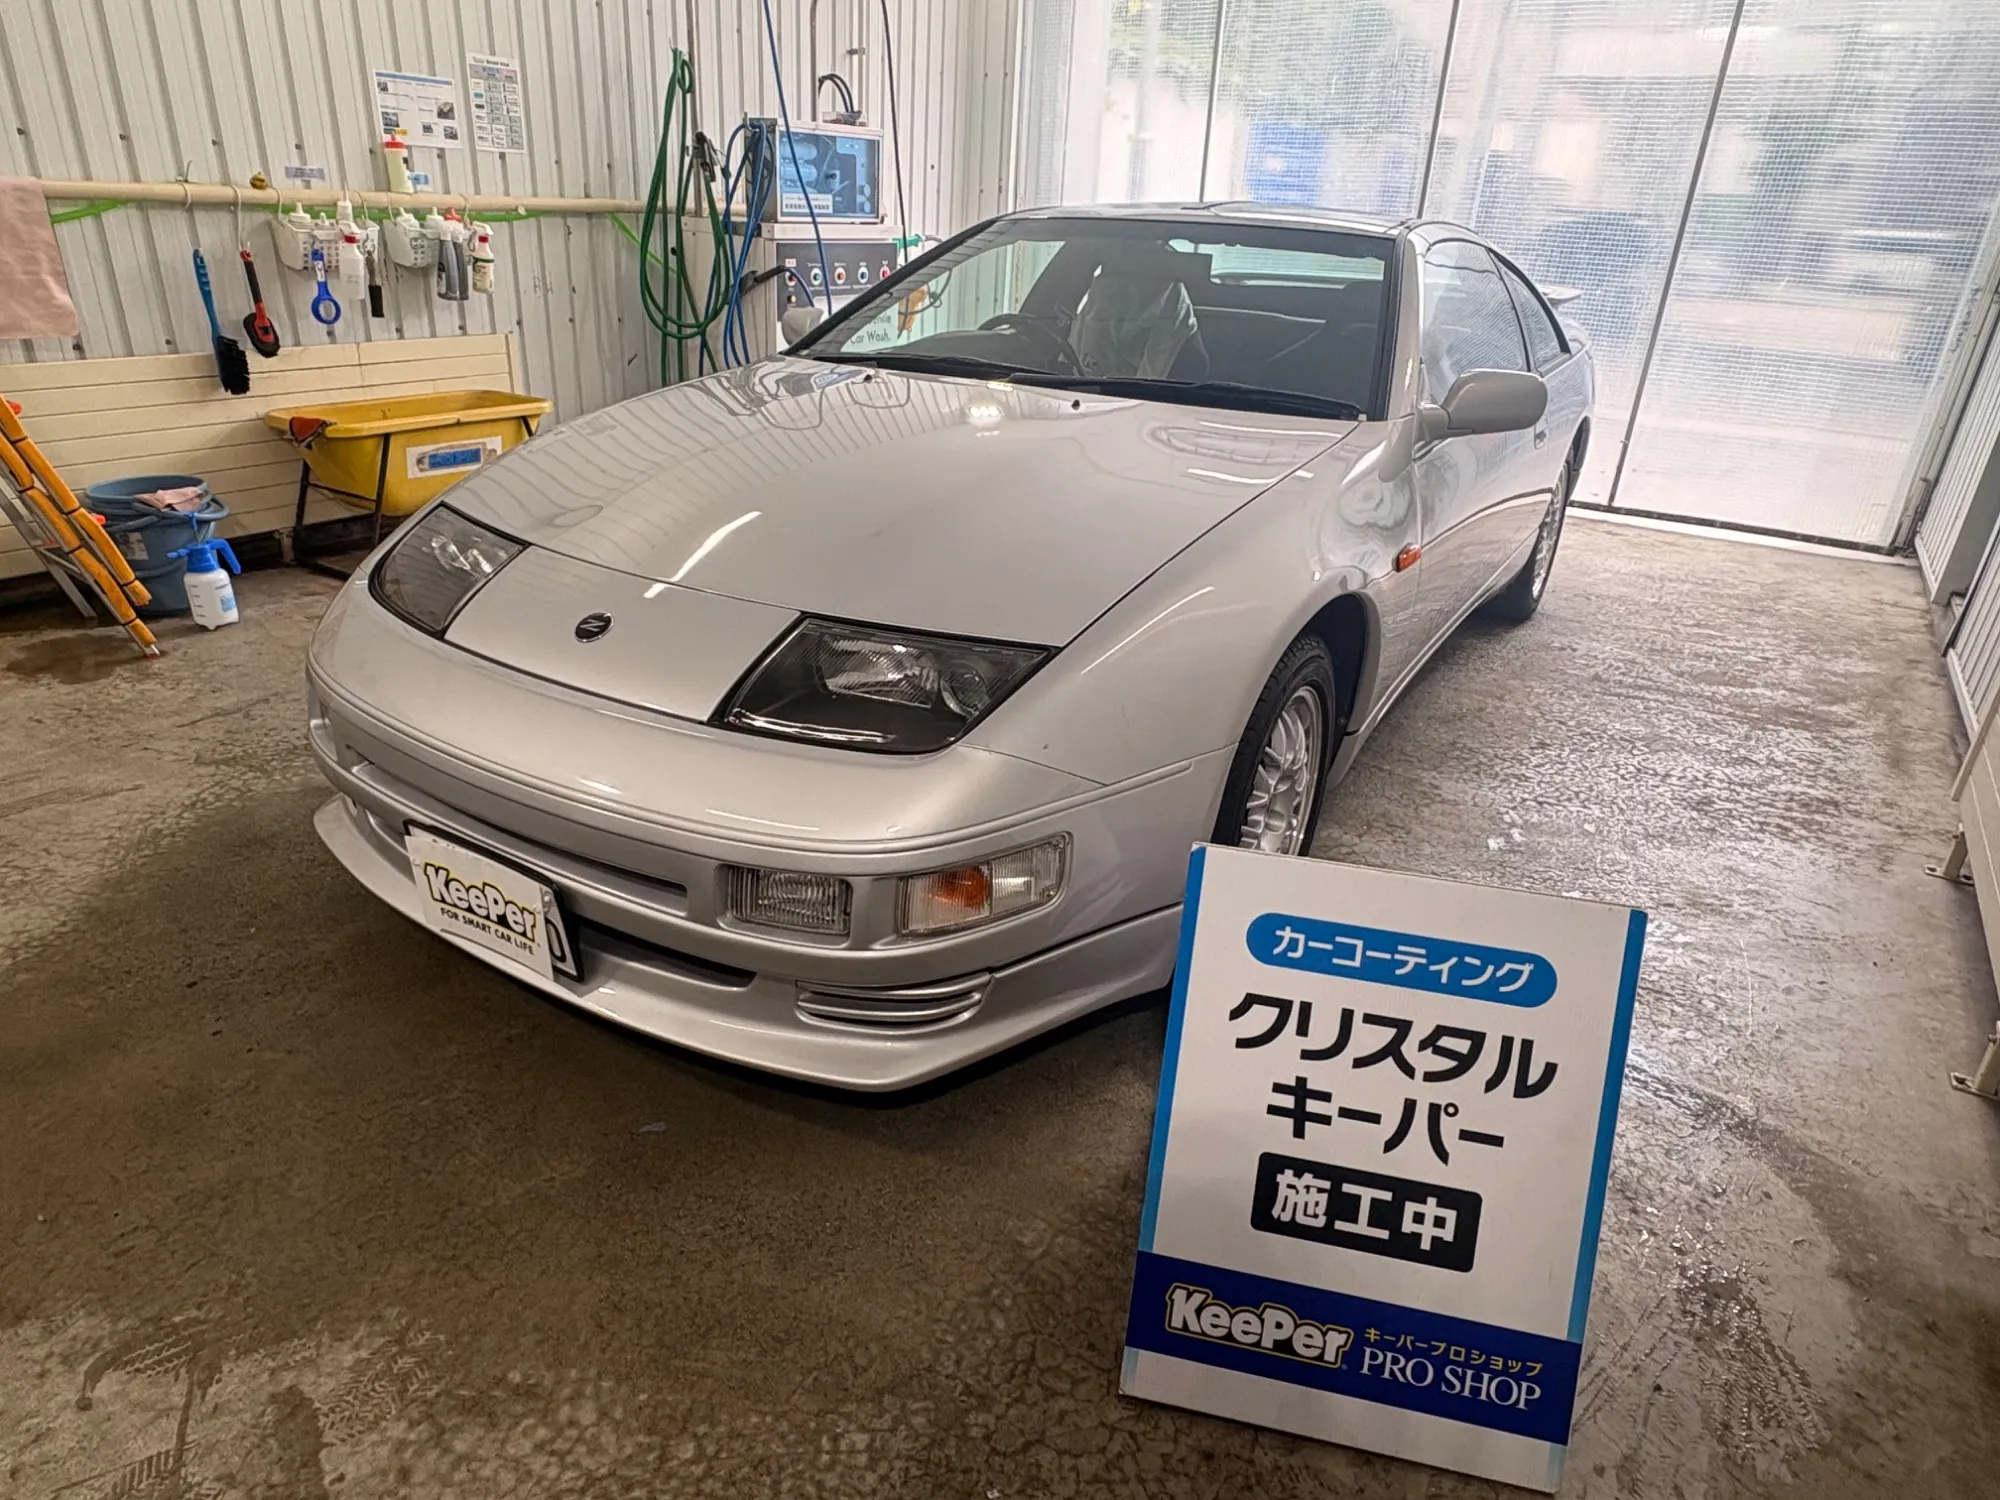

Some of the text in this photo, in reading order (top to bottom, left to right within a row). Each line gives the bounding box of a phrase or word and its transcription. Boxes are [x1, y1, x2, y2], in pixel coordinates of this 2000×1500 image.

[424, 862, 537, 942] KeePer
[440, 907, 535, 955] FOR SMART CAR LIFE
[1273, 926, 1534, 993] カーコーティング
[1229, 993, 1558, 1099] クリスタル
[1266, 1076, 1505, 1167] キーパー
[1271, 1169, 1460, 1252] 施工中
[1167, 1284, 1352, 1366] KeePer
[1363, 1327, 1544, 1377] キーパープロショップ
[1359, 1346, 1542, 1411] PRO SHOP
